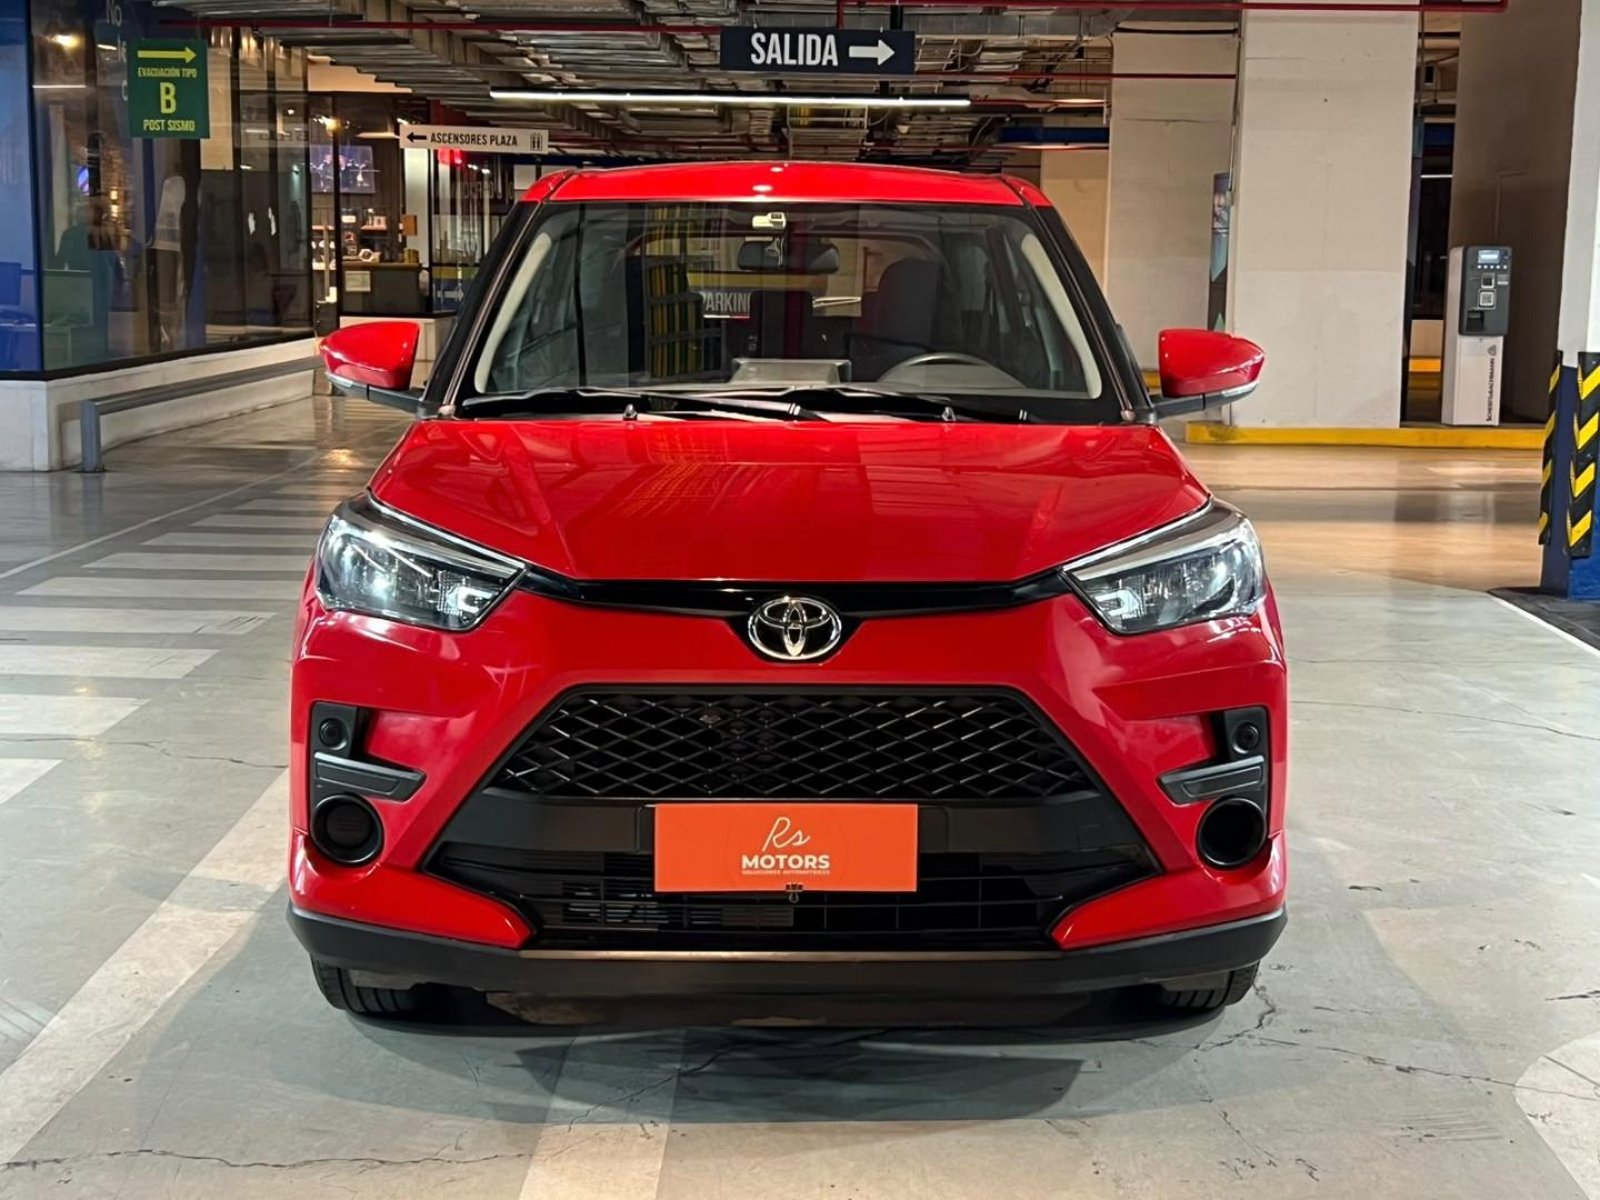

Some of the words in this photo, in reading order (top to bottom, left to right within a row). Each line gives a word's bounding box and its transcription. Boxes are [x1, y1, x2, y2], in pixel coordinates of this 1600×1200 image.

[750, 32, 839, 67] SALIDA
[181, 68, 197, 78] TIPO
[160, 82, 177, 114] B
[143, 119, 165, 131] POST
[167, 120, 195, 132] SISMO
[430, 132, 488, 145] ASCENSORES
[489, 134, 518, 147] PLAZA
[761, 816, 811, 852] Rs
[742, 854, 830, 869] MOTORS
